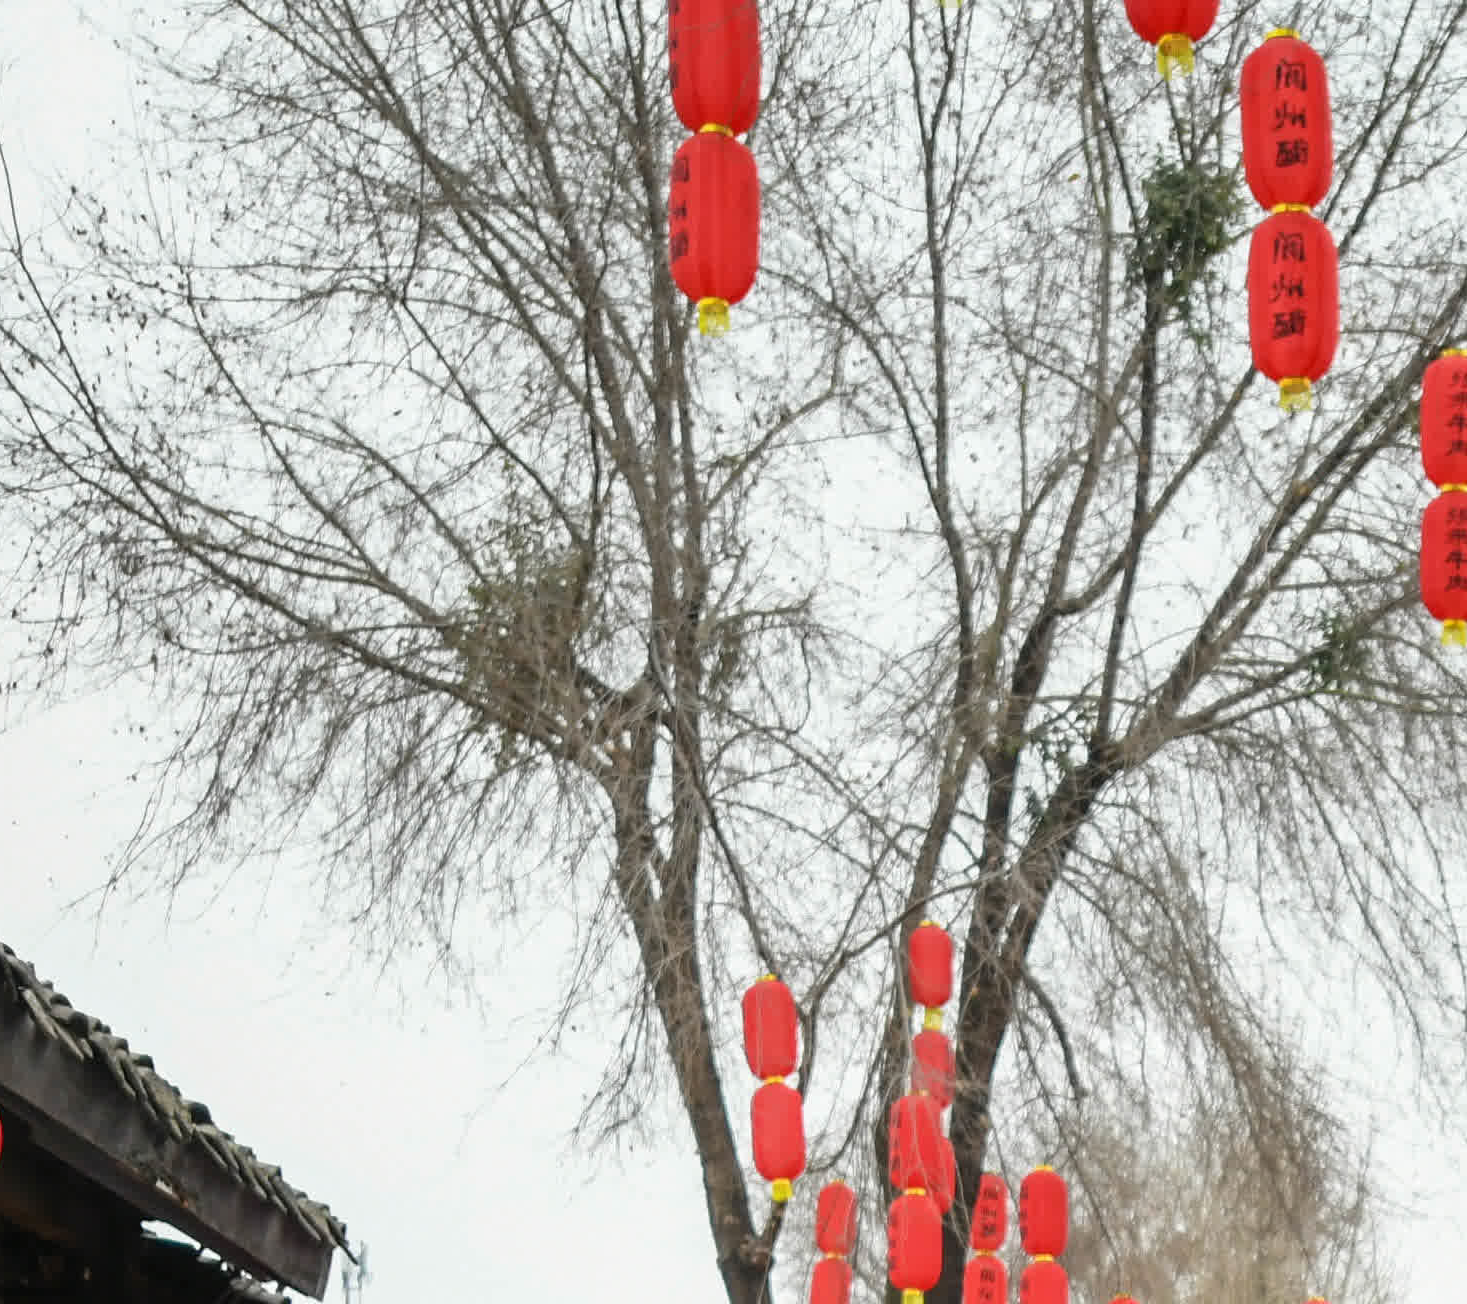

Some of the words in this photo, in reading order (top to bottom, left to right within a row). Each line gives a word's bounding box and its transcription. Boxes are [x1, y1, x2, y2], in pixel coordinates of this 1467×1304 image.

[1272, 58, 1309, 167] 阆州醋
[1270, 232, 1307, 339] 阆州醋
